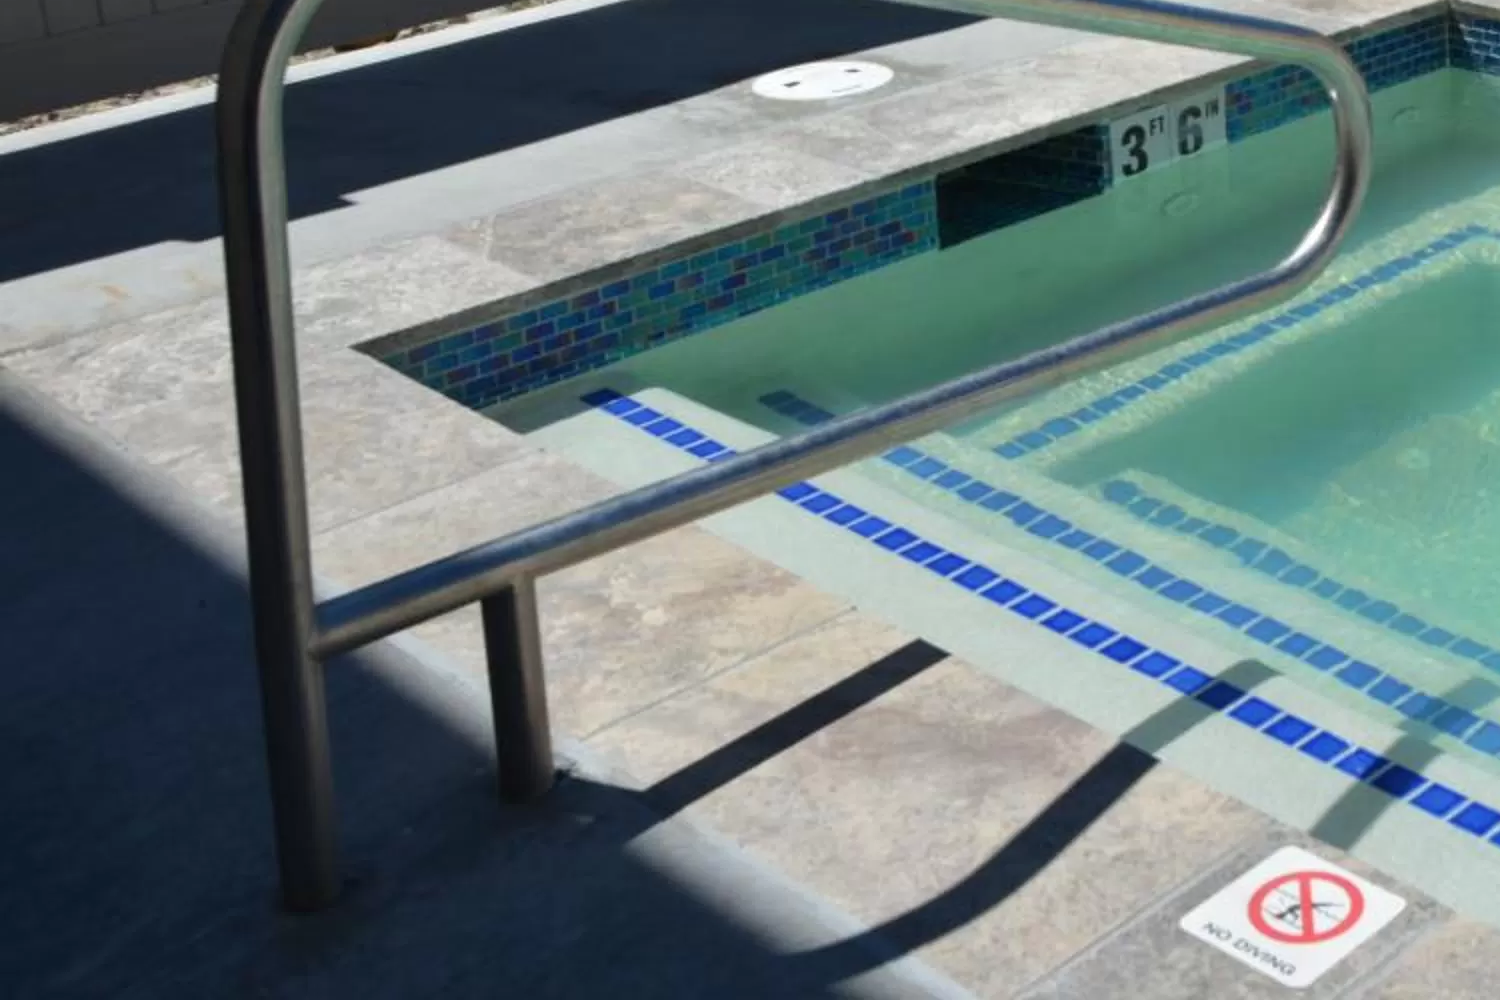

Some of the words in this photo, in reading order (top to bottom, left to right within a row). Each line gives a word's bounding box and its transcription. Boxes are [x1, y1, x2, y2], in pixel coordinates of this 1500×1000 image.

[1121, 124, 1148, 177] 3
[1149, 115, 1165, 136] FT
[1178, 105, 1203, 156] 6
[1204, 921, 1232, 942] NO
[1234, 938, 1296, 976] DIVING
